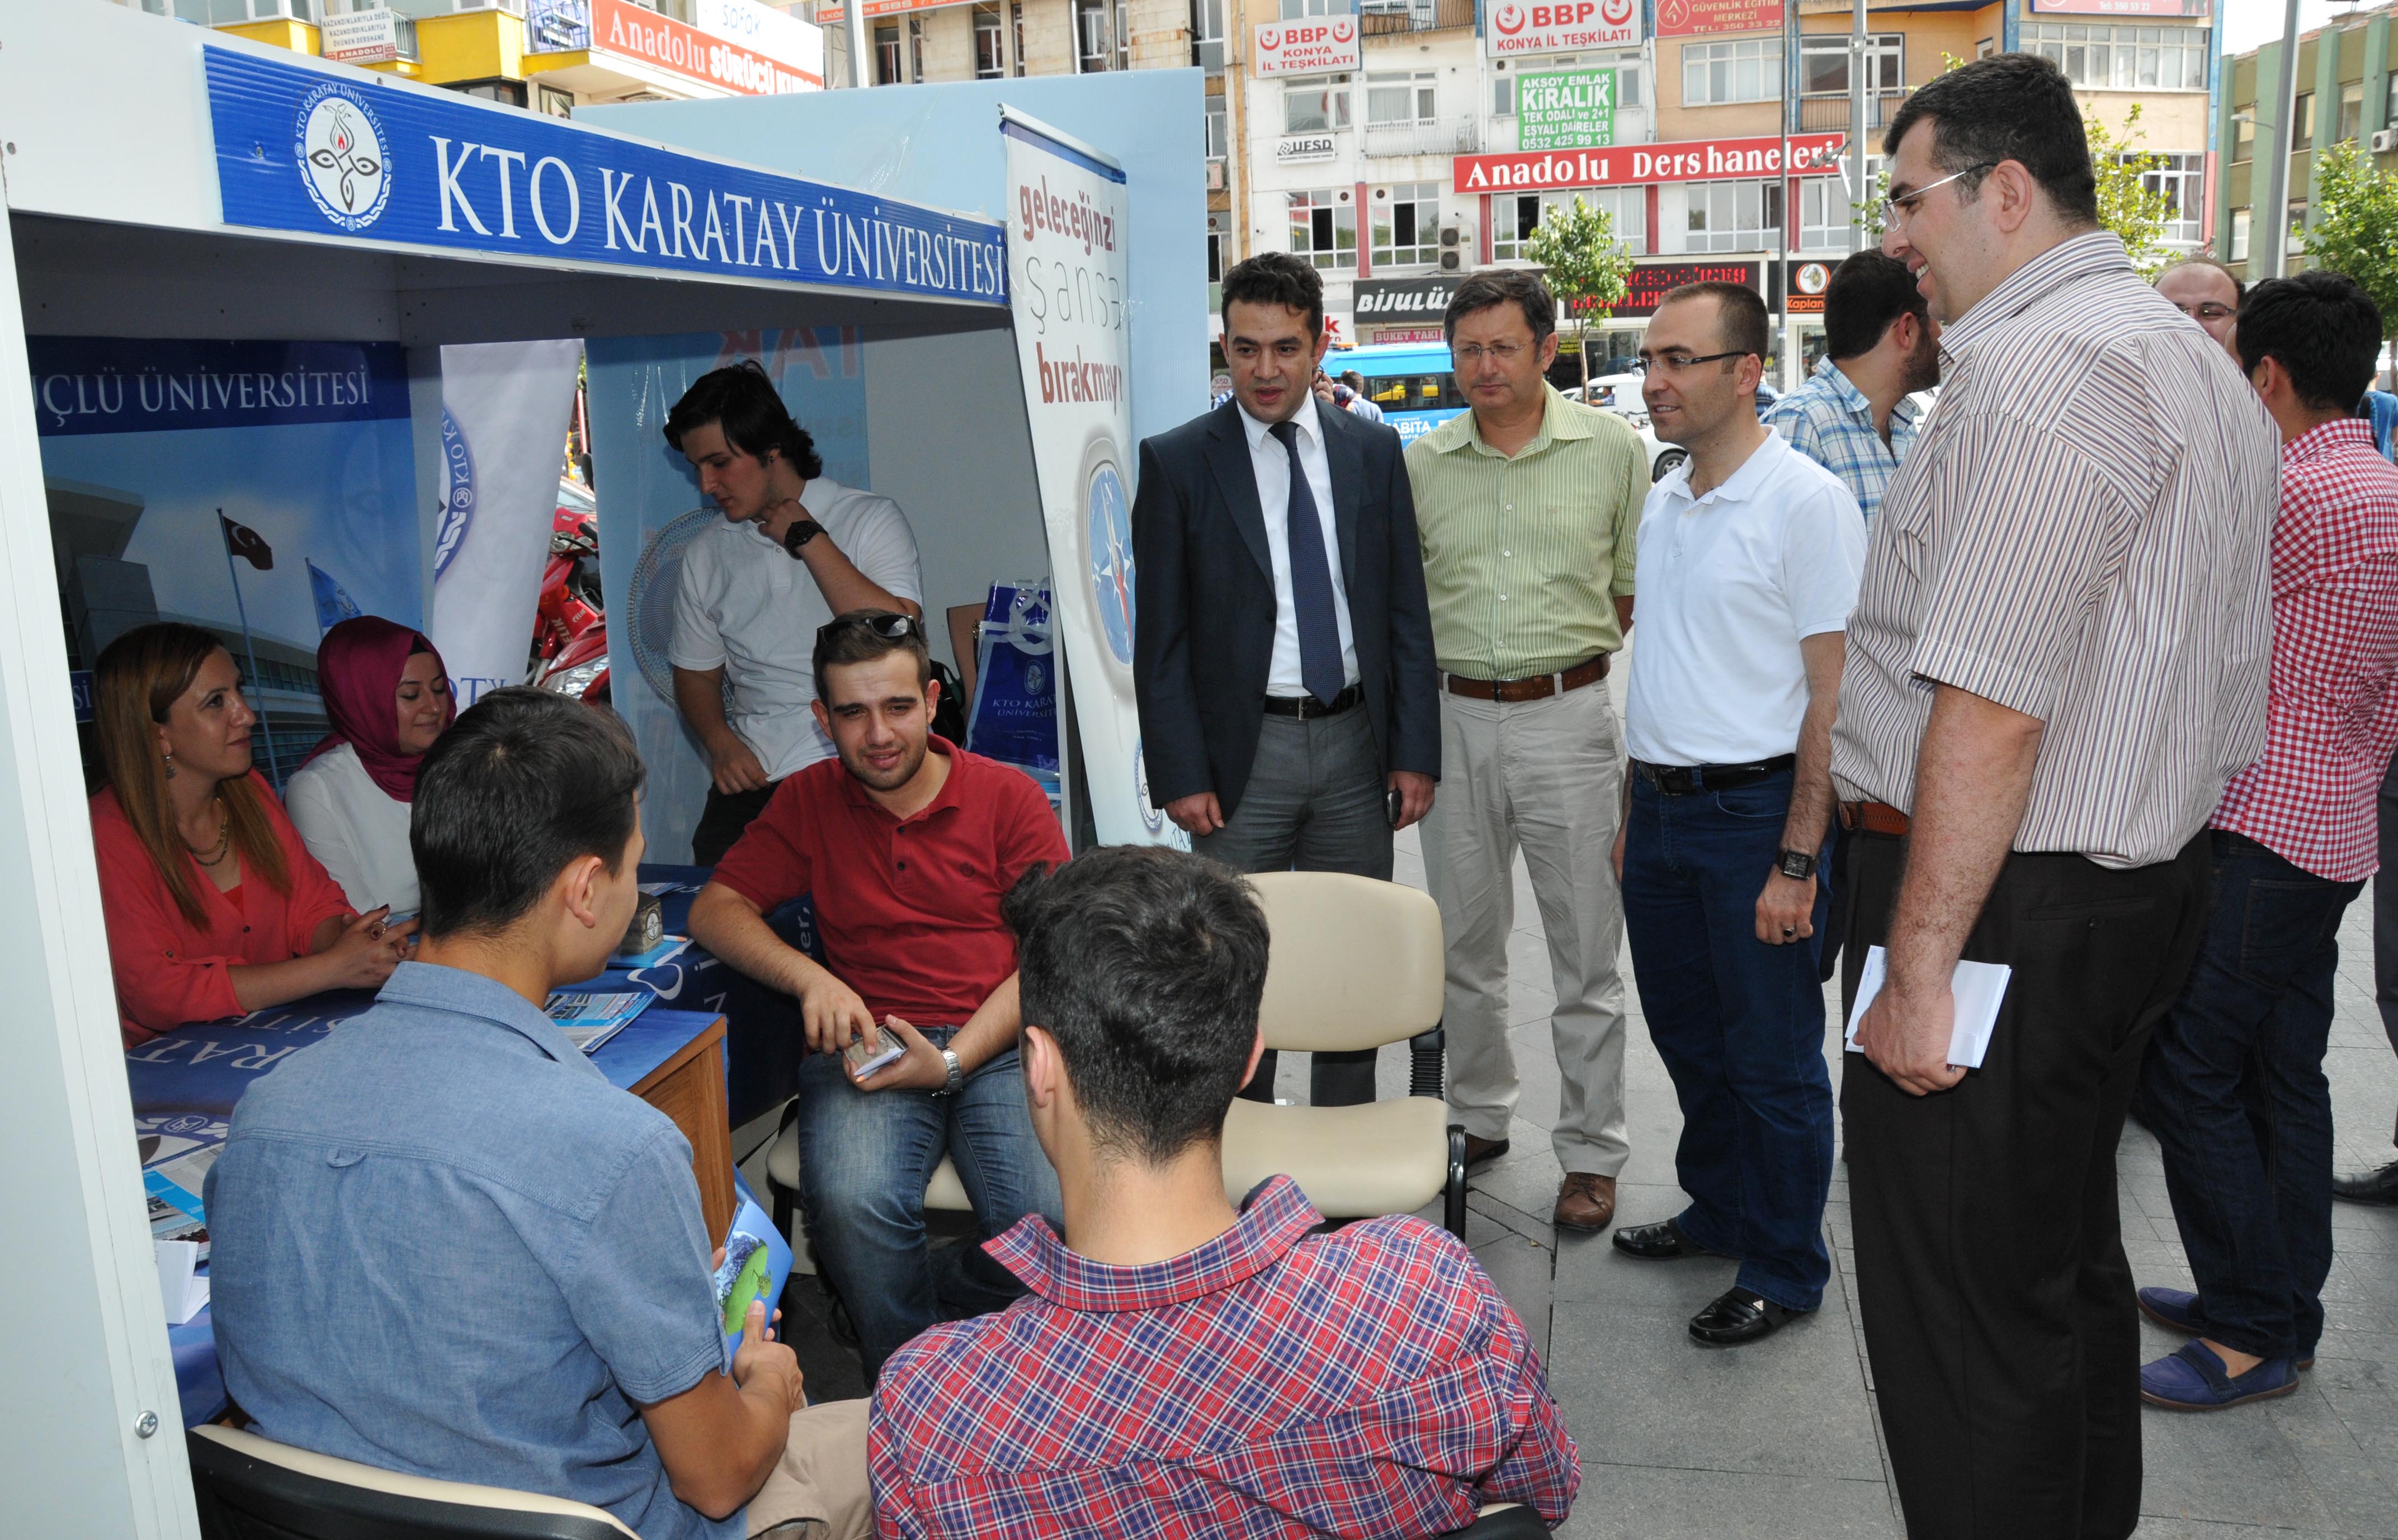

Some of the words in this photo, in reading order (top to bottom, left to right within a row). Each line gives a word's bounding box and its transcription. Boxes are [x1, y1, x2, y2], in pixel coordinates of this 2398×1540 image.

[1692, 0, 1741, 12] GÜVENLİK
[1532, 2, 1594, 27] BBP
[1714, 10, 1757, 22] MERKEZİ
[357, 34, 384, 44] DERSHANE
[609, 10, 706, 74] Anadolu
[1285, 27, 1328, 45] BBP
[1497, 37, 1542, 51] KONYA
[1547, 33, 1558, 46] İL
[1563, 29, 1631, 47] TEŞKİLATI
[339, 46, 383, 59] ANADOLU
[1283, 45, 1332, 58] KONYA
[1263, 60, 1275, 71] İL
[1280, 55, 1353, 70] TEŞKİLATI
[1522, 77, 1565, 88] AKSOY
[1568, 73, 1611, 86] EMLAK
[296, 111, 307, 139] KTO
[303, 83, 338, 111] KARATAY
[1523, 111, 1543, 124] TEK
[1547, 108, 1575, 122] ODALI
[1578, 111, 1589, 121] ve
[1524, 123, 1559, 138] EŞYALI
[1522, 137, 1551, 150] 0532
[1554, 135, 1573, 147] 425
[1577, 134, 1592, 147] 99
[1595, 134, 1609, 146] 13
[1466, 153, 1609, 188] Anadolu
[429, 135, 579, 244] KTO
[598, 167, 804, 271] KARATAY
[813, 196, 1006, 296] ÜNİVERSİTESİ
[1026, 256, 1121, 335] şansa
[1788, 299, 1824, 310] Kaplan
[1376, 331, 1410, 341] BUKET
[1413, 330, 1438, 339] TAKI
[139, 364, 370, 413] ÜNİVERSİTESİ
